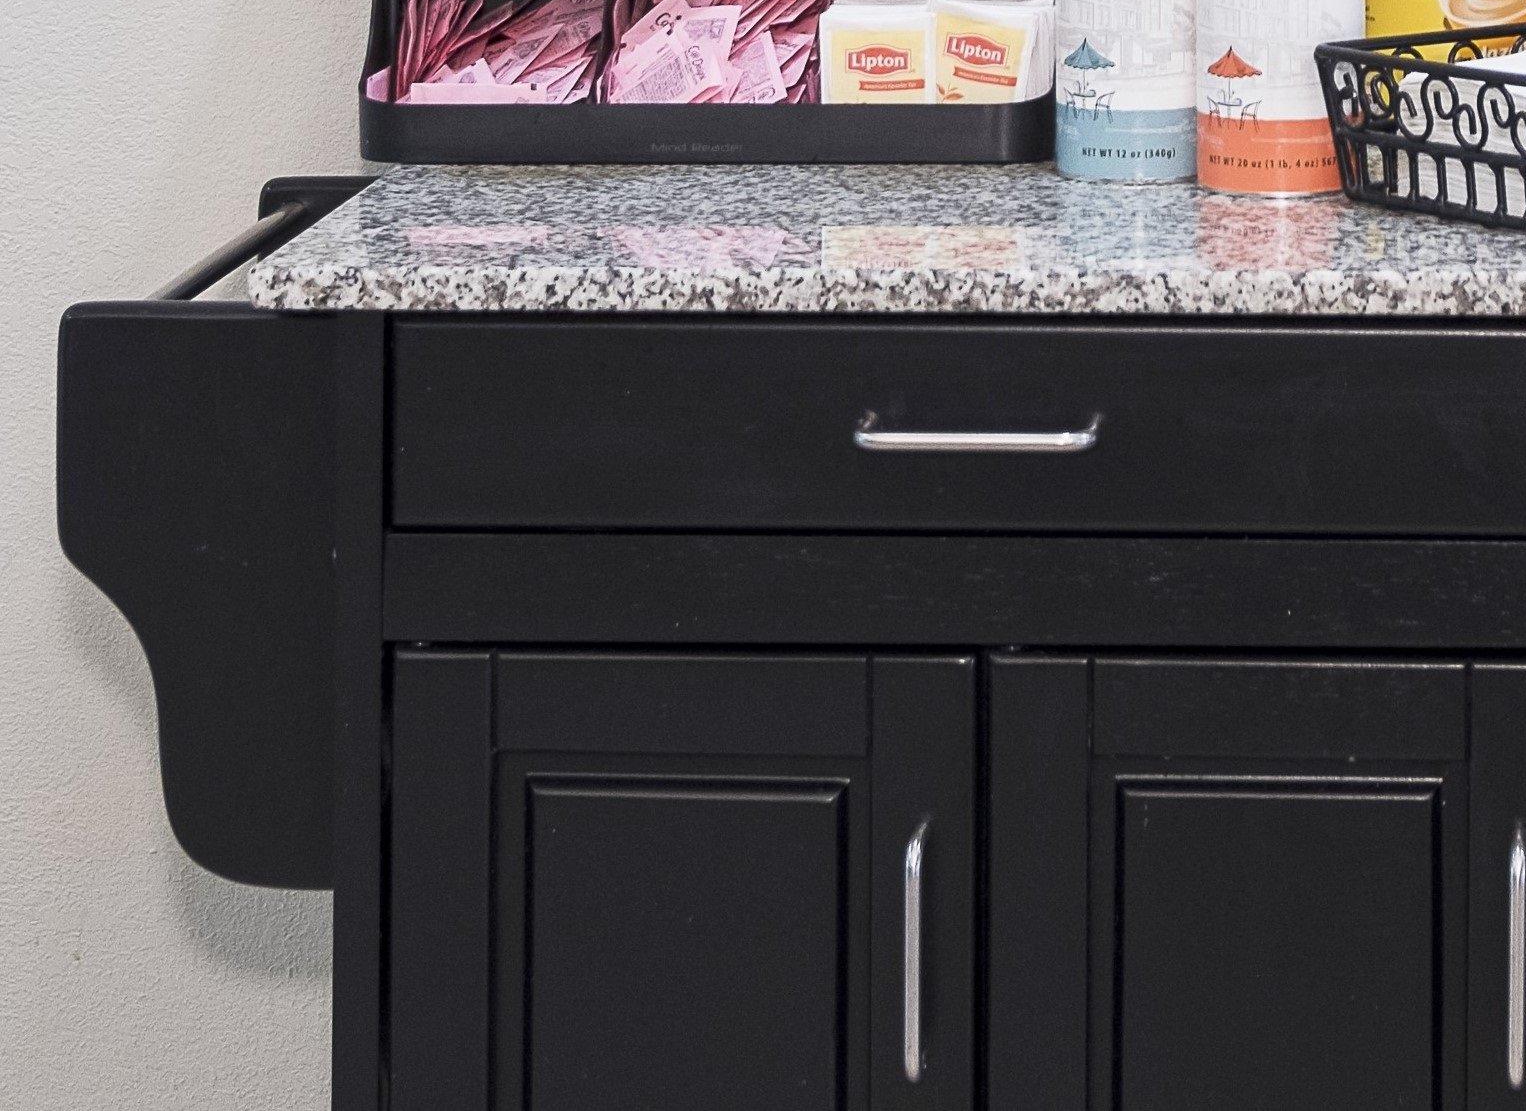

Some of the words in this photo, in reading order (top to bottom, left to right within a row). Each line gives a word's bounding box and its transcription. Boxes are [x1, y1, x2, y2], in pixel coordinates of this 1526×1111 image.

[950, 39, 1003, 62] Lipton
[851, 52, 905, 72] Lipton
[1082, 147, 1097, 157] NET
[1099, 148, 1113, 158] WT
[1116, 149, 1127, 158] 12
[1144, 147, 1177, 160] (340g)
[1209, 154, 1221, 165] NET
[1223, 155, 1235, 166] WT
[1237, 158, 1249, 168] 20
[1321, 156, 1337, 167] 567
